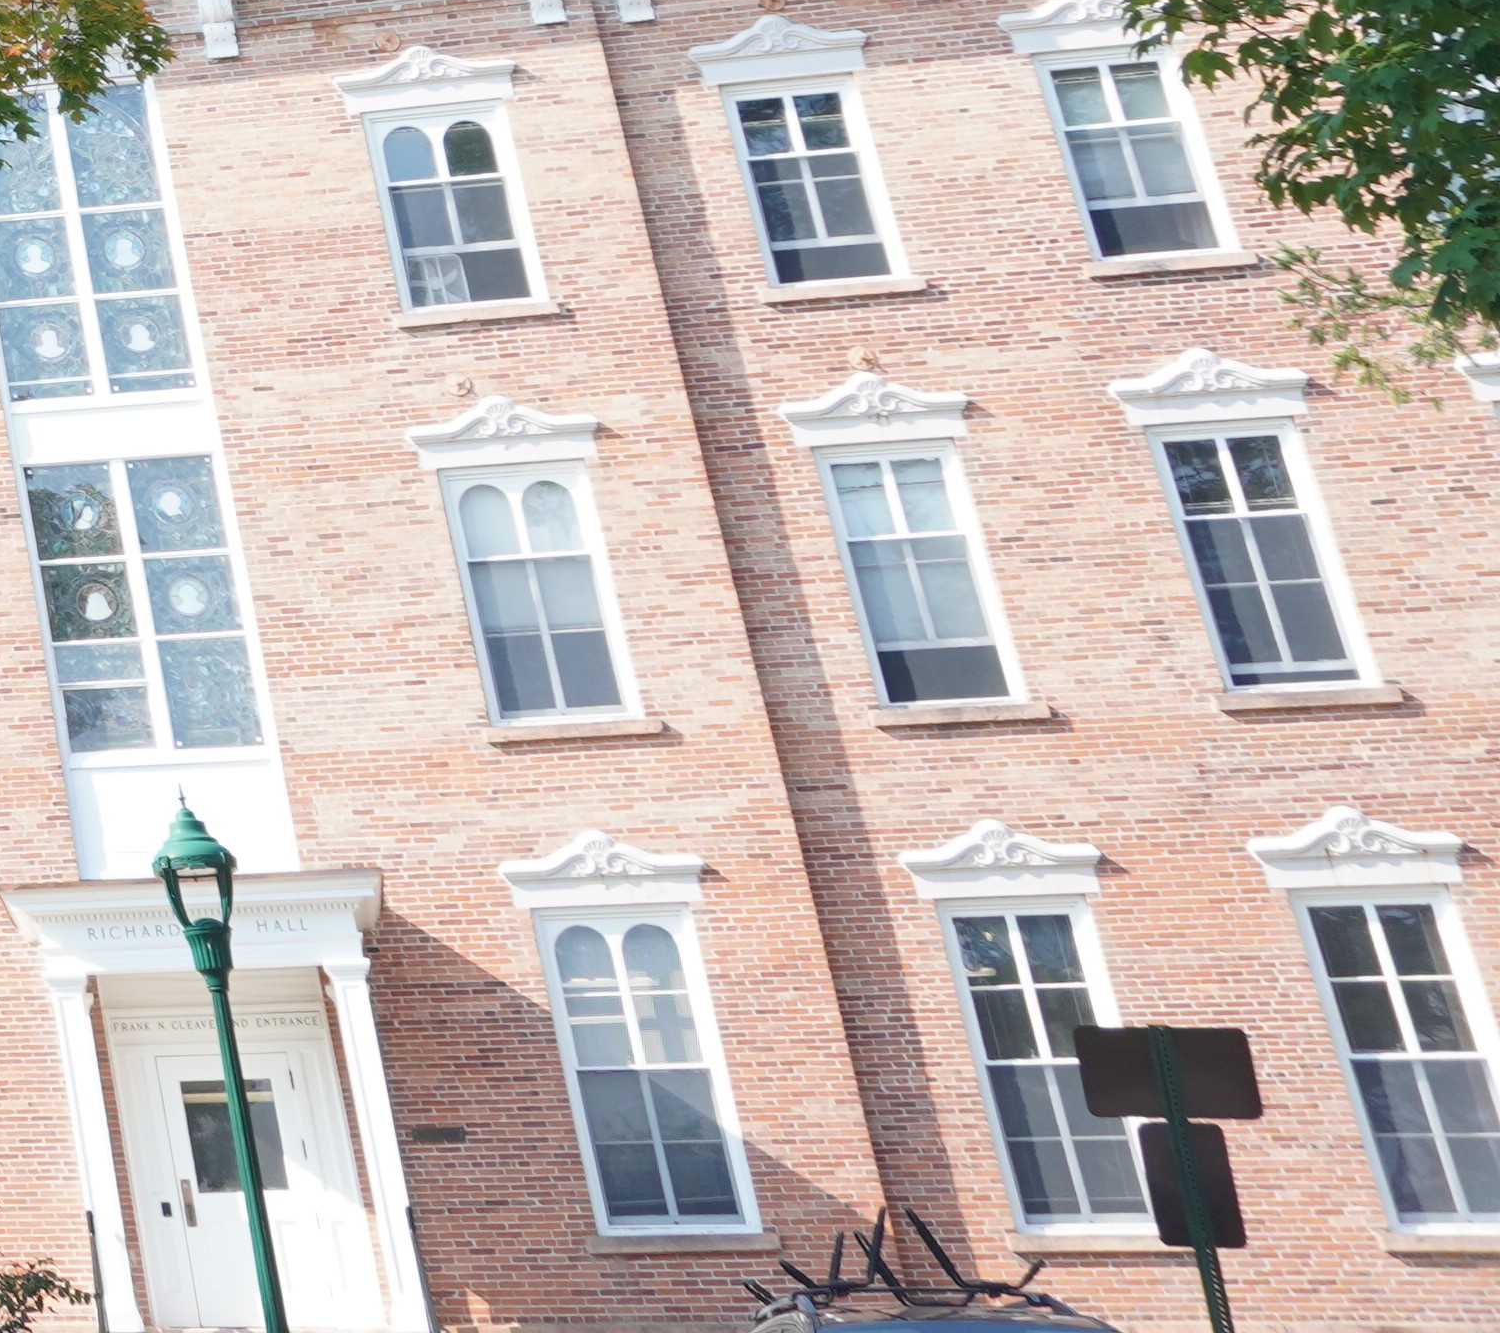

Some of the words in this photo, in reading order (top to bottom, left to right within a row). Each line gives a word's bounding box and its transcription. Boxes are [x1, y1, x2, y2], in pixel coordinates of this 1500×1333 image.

[256, 917, 309, 933] HALL
[112, 1021, 150, 1033] FRANK
[171, 1017, 249, 1031] CLEAVEND
[256, 1015, 319, 1029] ENTRANCE
